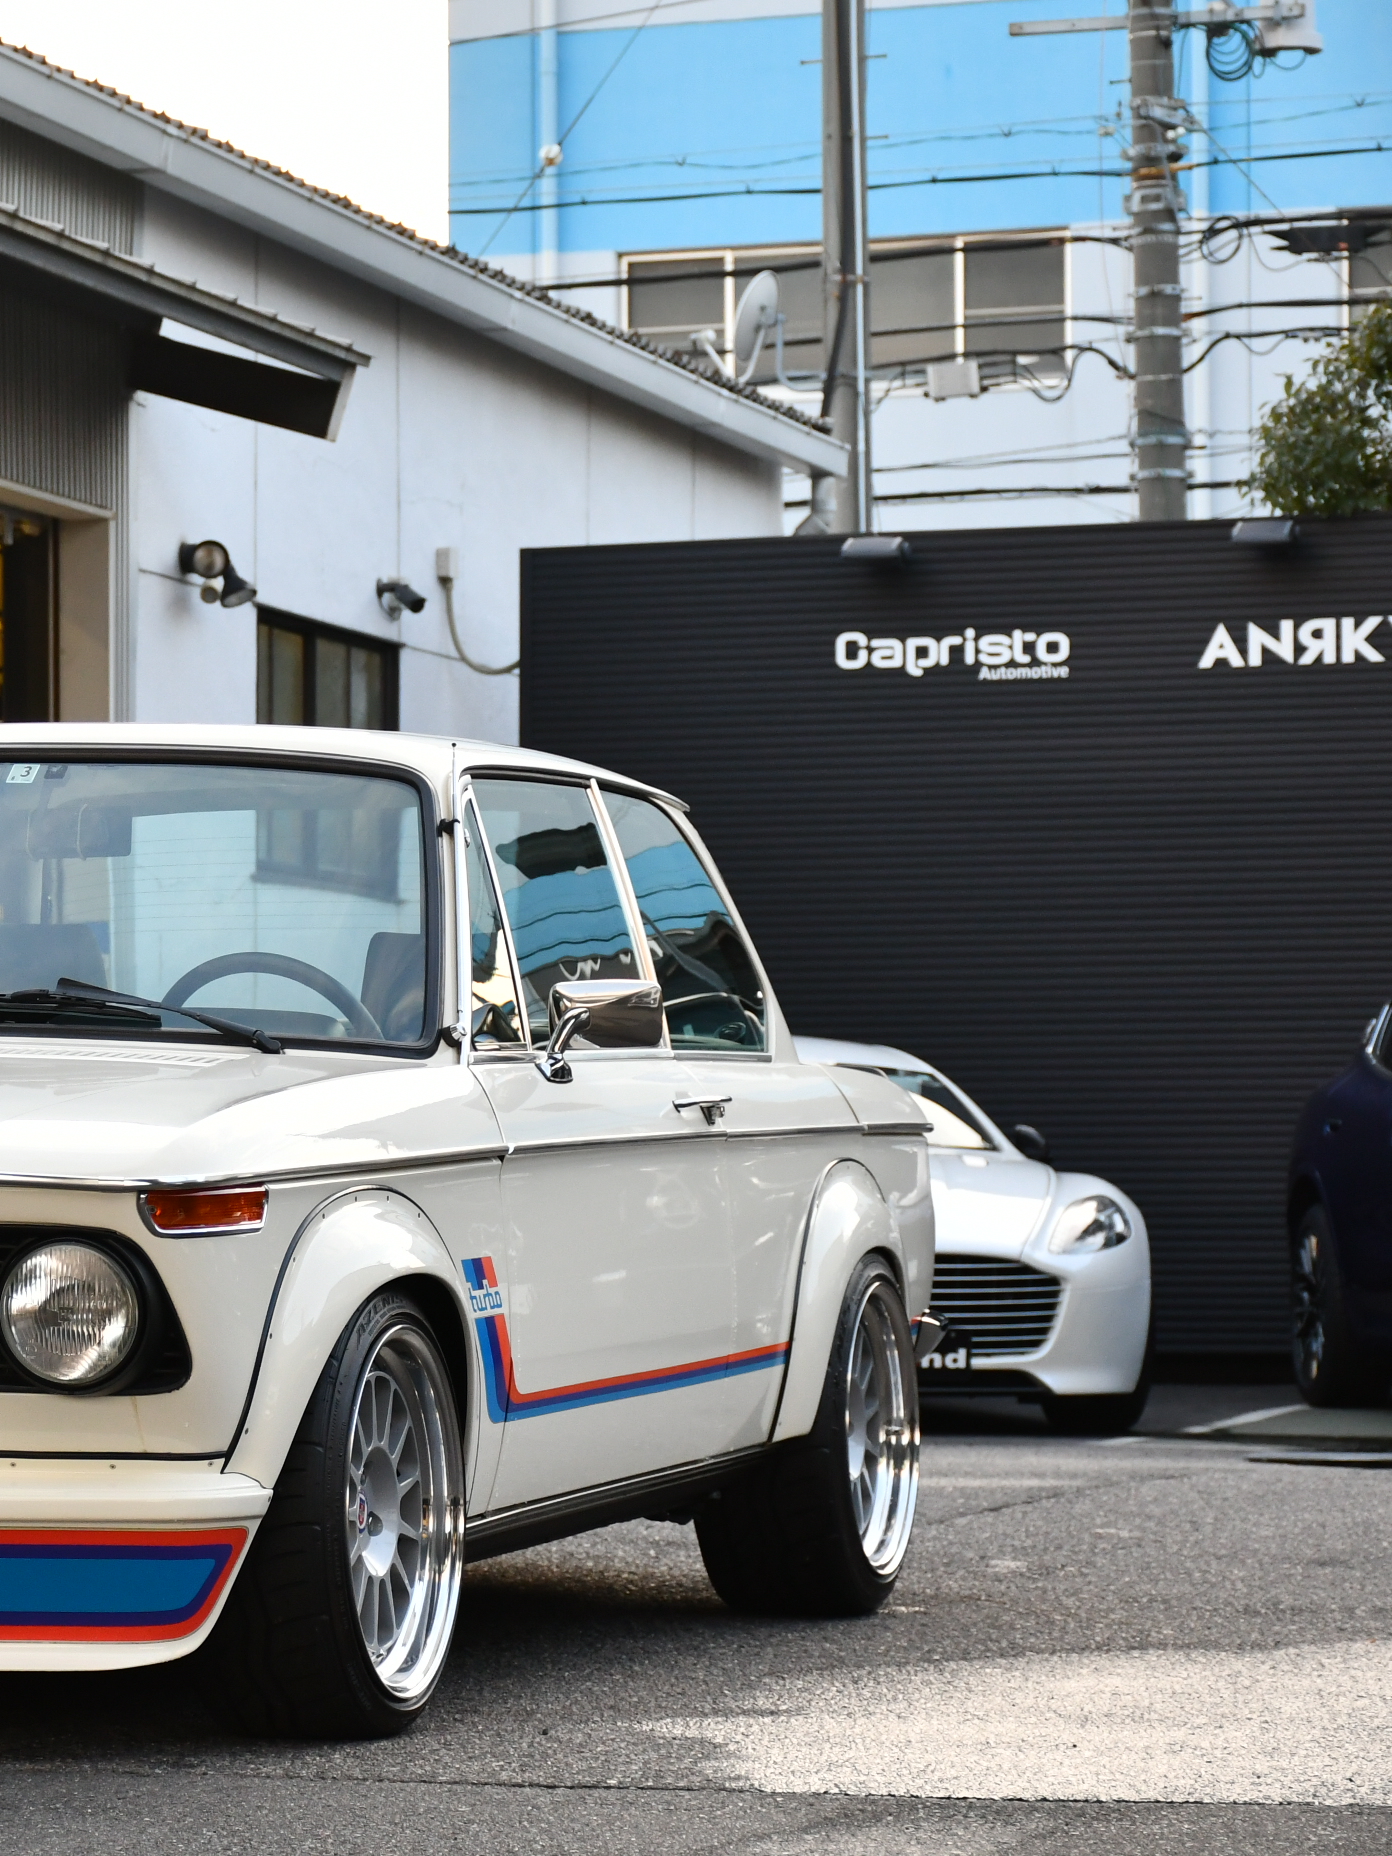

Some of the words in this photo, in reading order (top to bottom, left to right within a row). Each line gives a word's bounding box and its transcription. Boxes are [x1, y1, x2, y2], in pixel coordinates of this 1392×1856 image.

[834, 627, 1071, 677] Capristo
[978, 664, 1070, 681] Automotive
[20, 765, 33, 777] 3
[468, 1283, 503, 1313] turbo
[917, 1347, 968, 1369] nd
